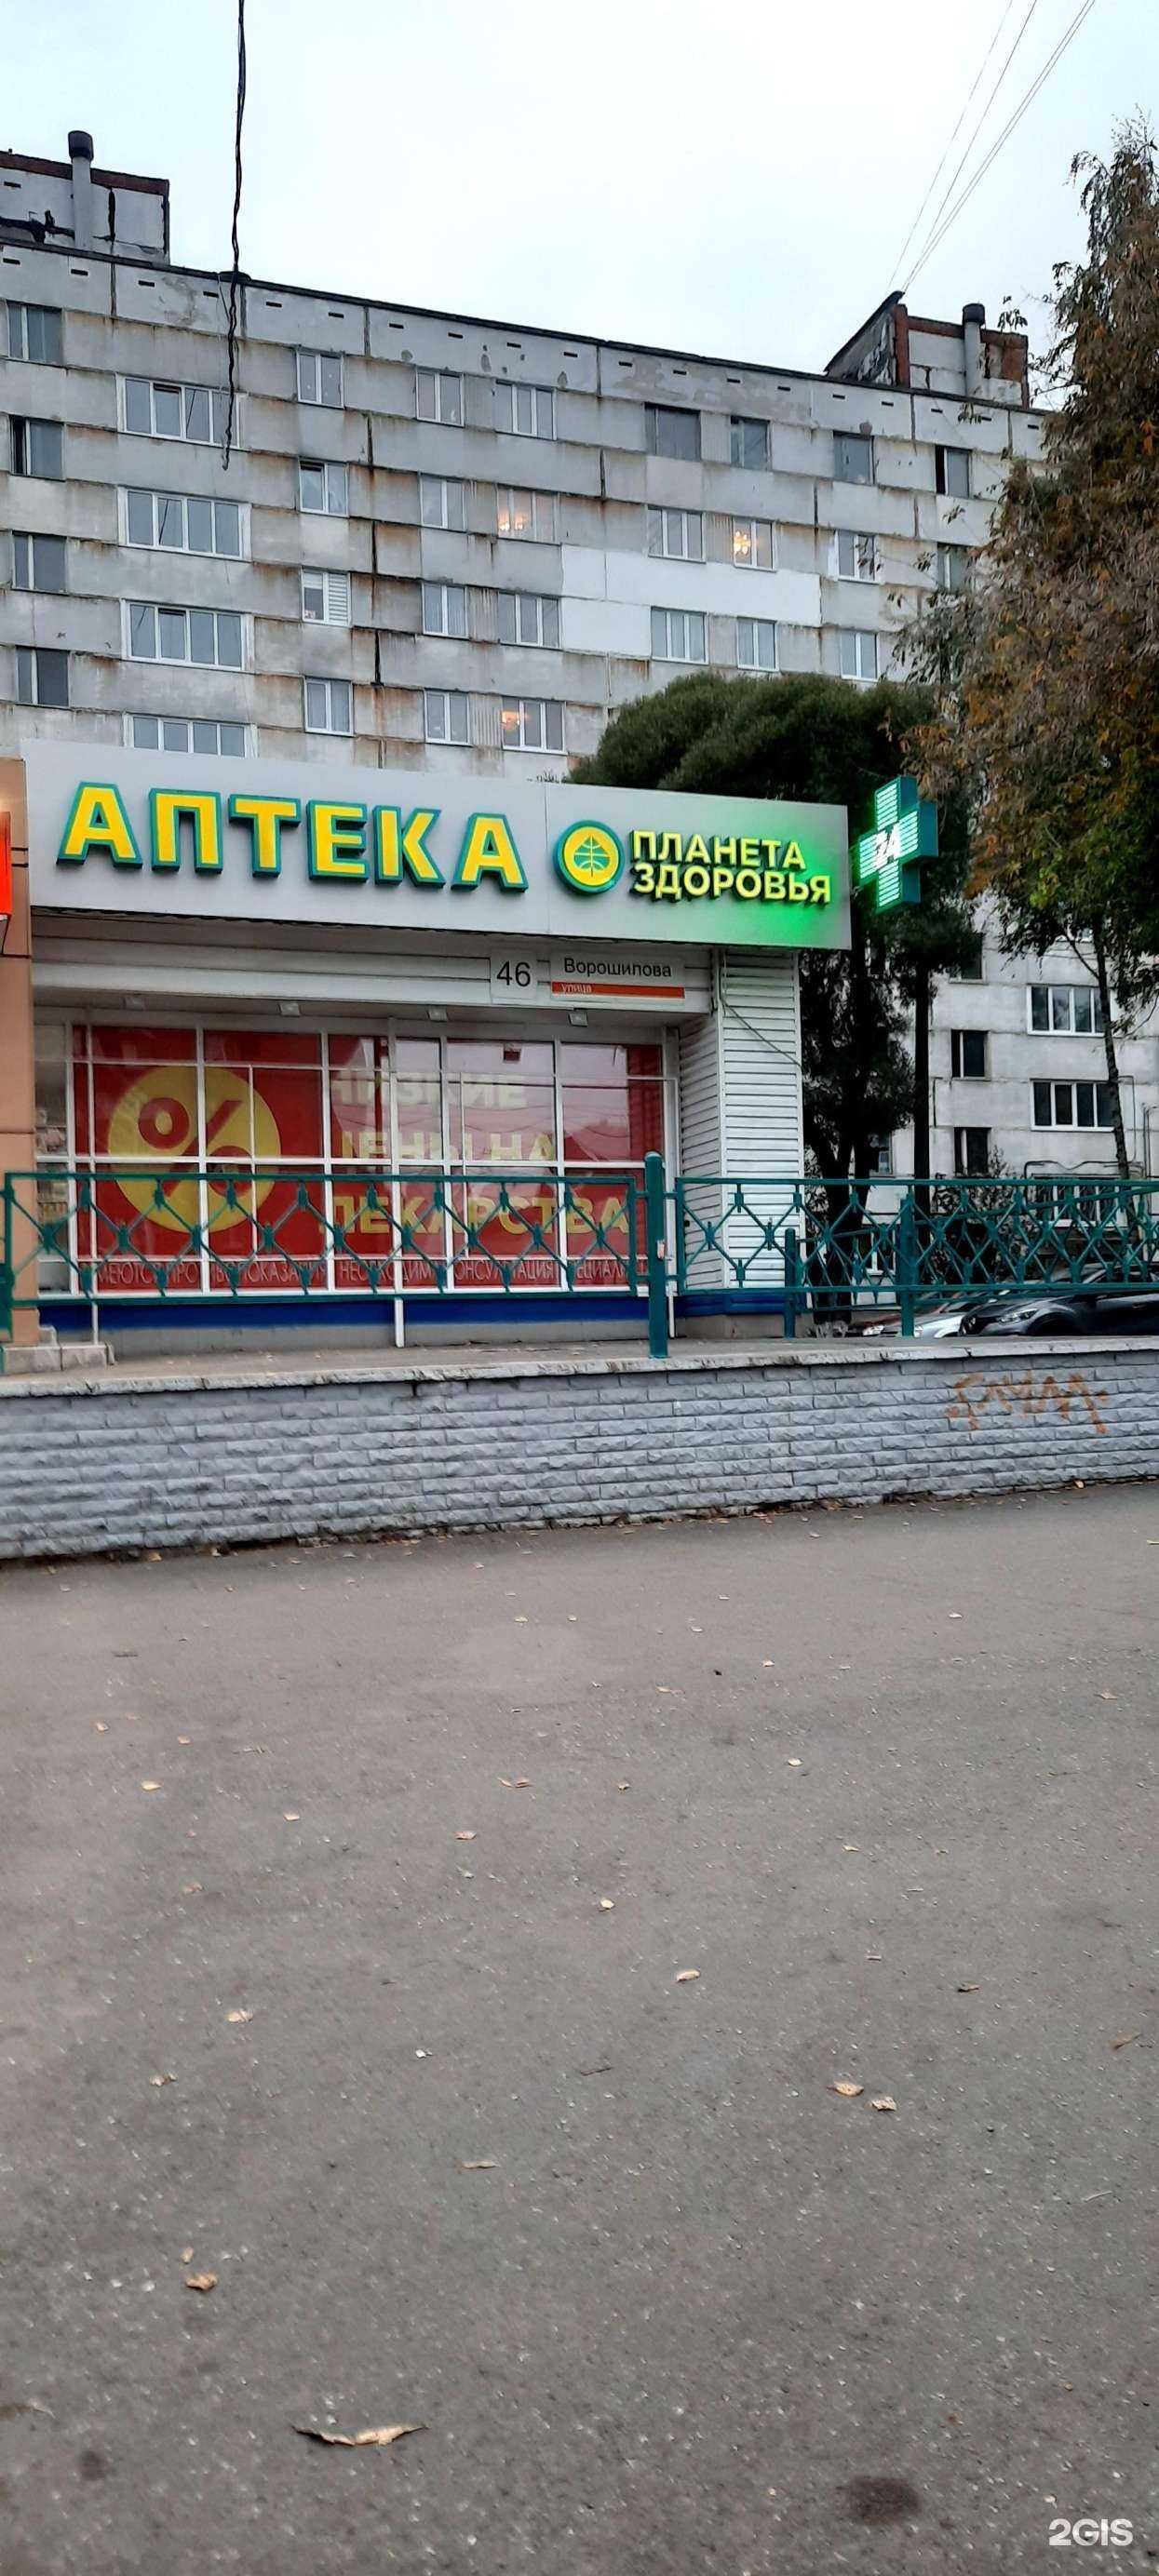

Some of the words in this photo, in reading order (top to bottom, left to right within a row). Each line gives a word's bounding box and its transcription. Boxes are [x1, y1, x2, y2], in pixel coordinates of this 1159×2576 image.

[57, 782, 528, 891] АПТЕКА
[631, 829, 806, 869] ПЛАНЕТА
[873, 824, 902, 869] 24
[632, 863, 831, 903] ЗДОРОВЬЯ
[496, 961, 532, 986] 46
[563, 958, 672, 977] Ворошилова
[490, 1133, 558, 1161] НА
[319, 1195, 630, 1235] ЛЕКАРСТВА
